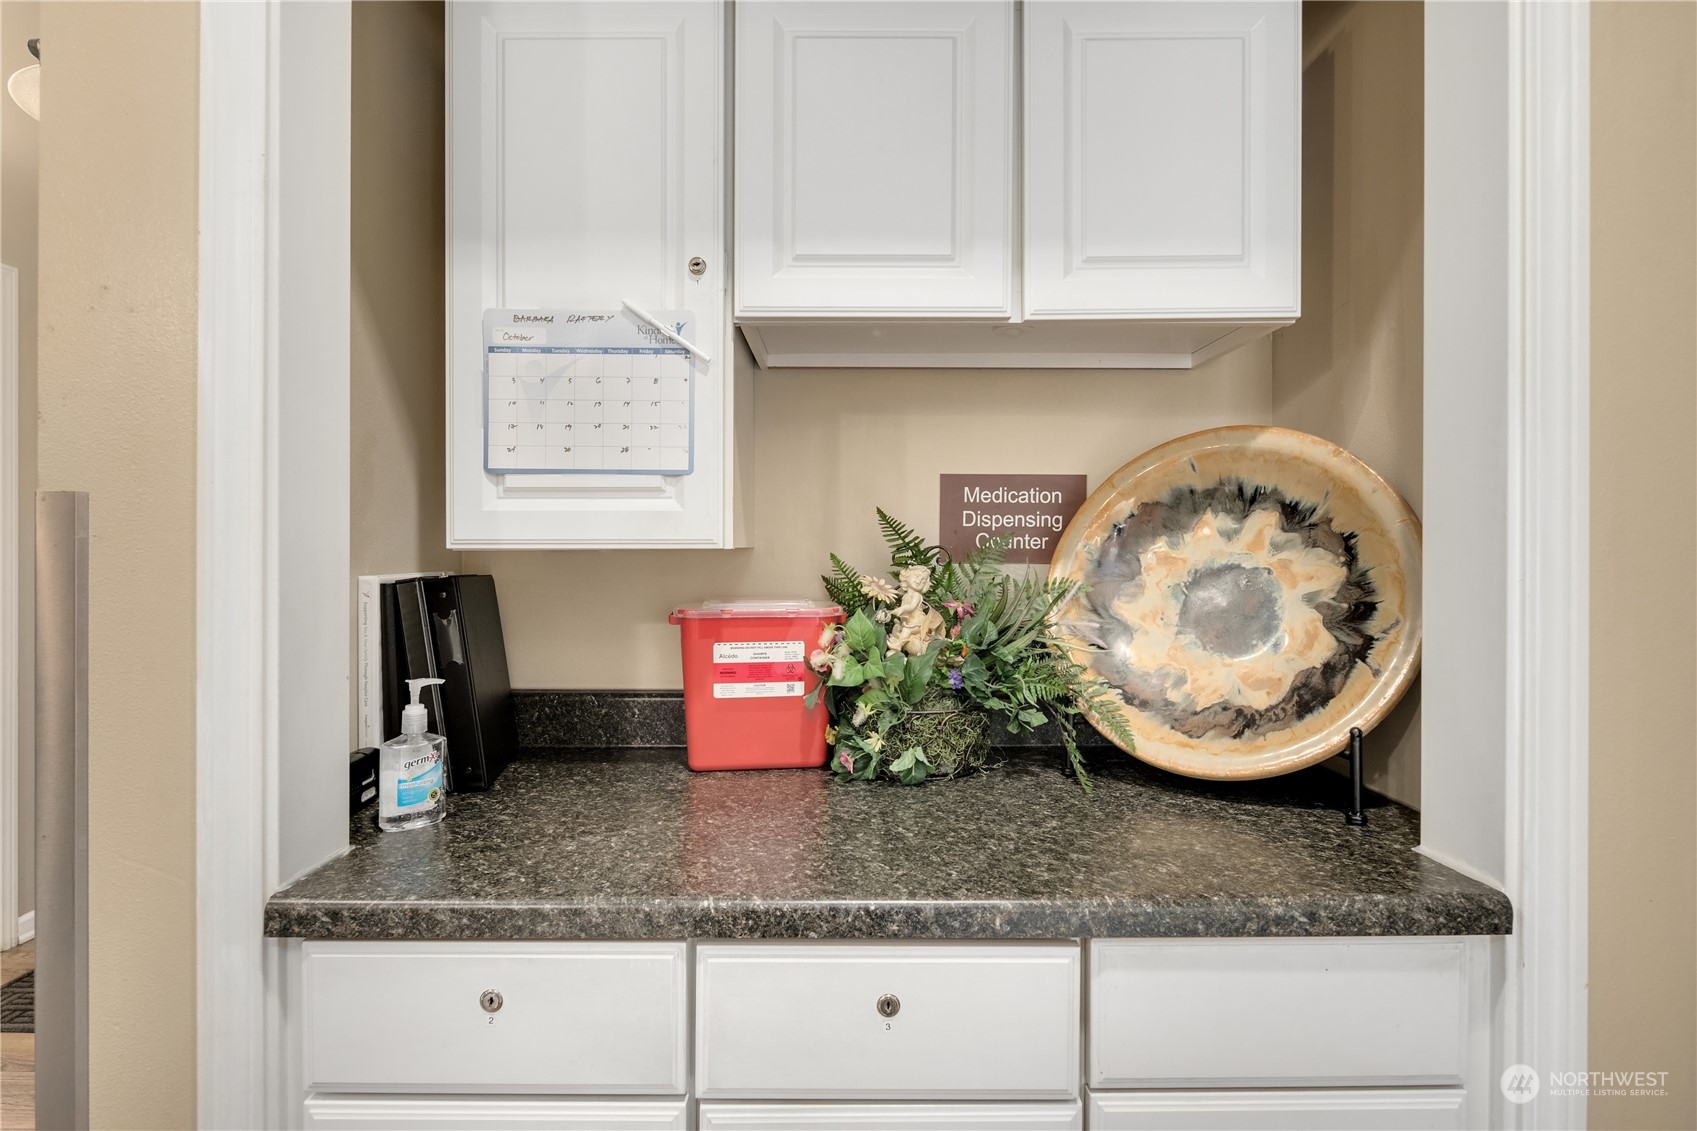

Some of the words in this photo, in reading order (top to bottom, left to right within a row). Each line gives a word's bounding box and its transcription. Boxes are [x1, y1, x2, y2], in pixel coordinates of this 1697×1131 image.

[502, 331, 534, 342] October
[963, 487, 1063, 504] Medication
[962, 510, 1063, 532] Dispensing
[488, 1016, 494, 1025] 2
[885, 1022, 891, 1031] 3
